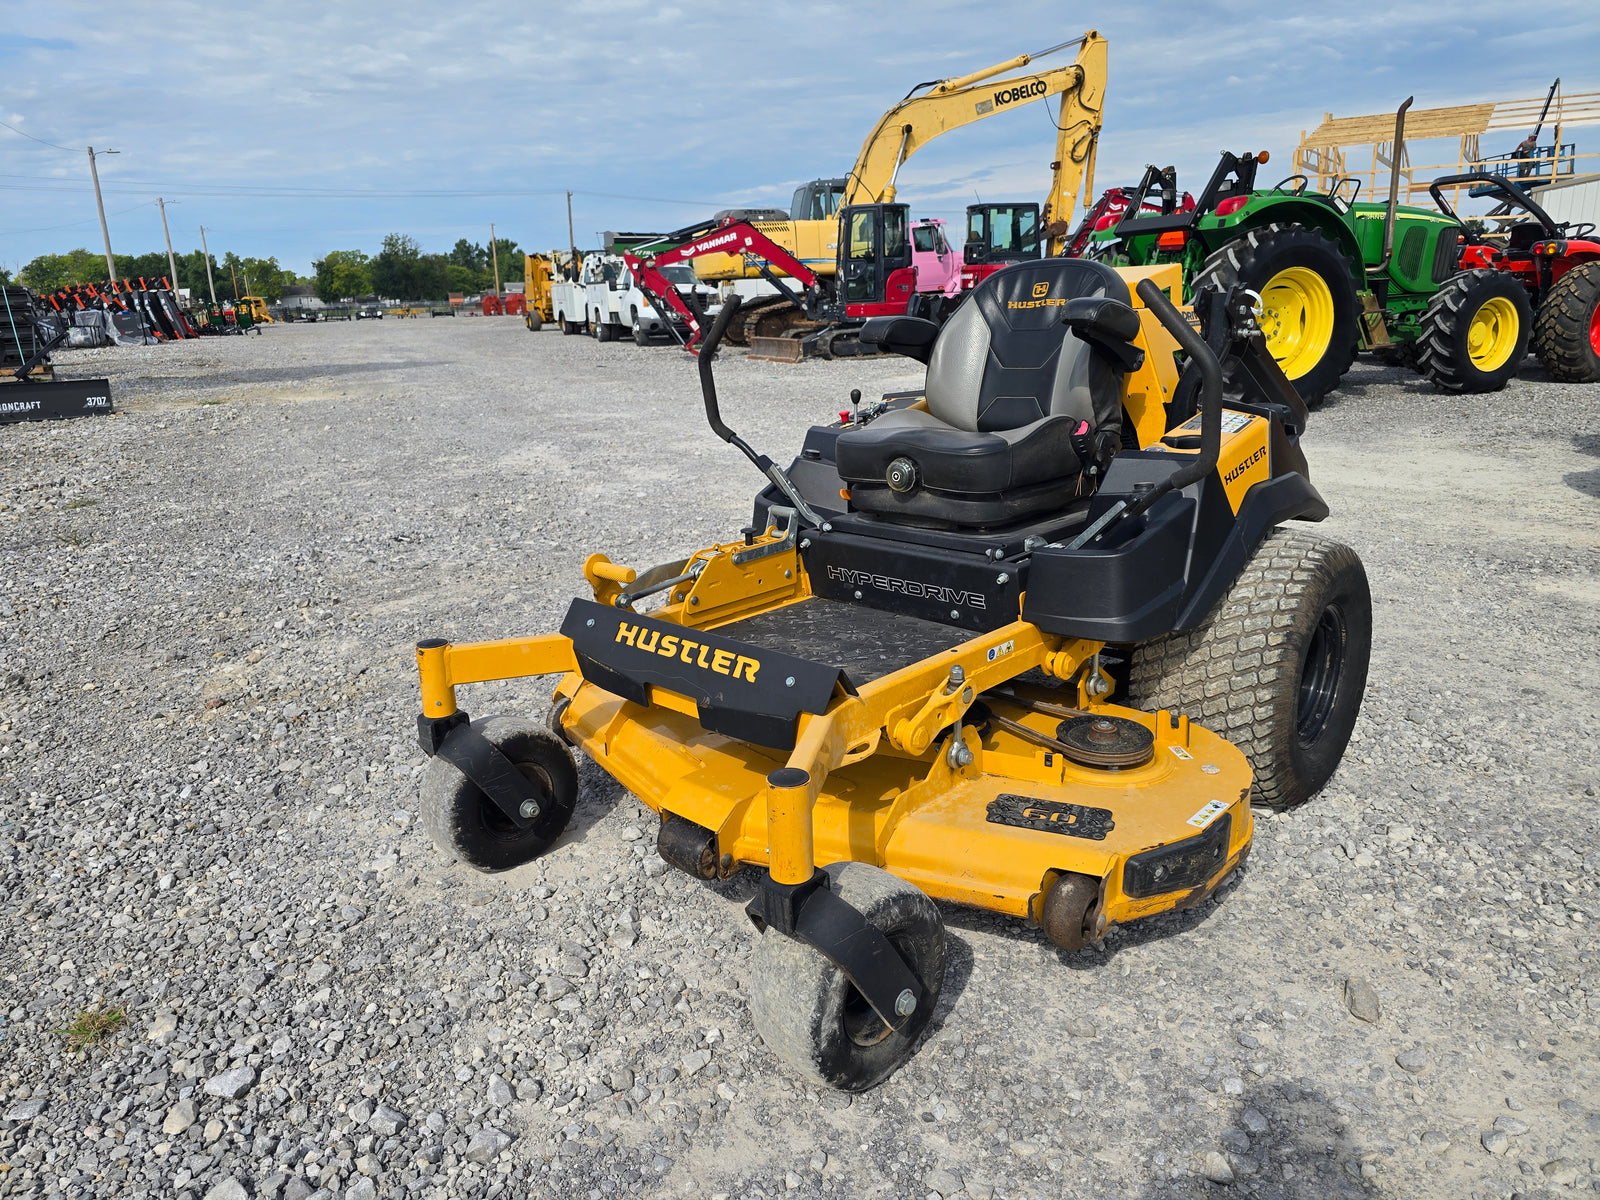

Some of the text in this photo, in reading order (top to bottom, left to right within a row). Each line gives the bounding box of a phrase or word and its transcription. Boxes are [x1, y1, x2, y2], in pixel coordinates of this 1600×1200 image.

[994, 80, 1047, 107] KOBELCO
[696, 232, 738, 252] YANMAR
[1007, 298, 1066, 309] HUSTLER
[86, 396, 107, 406] 3707
[1223, 445, 1267, 486] HUSTLER
[827, 565, 986, 609] HYPERDRIVE
[614, 621, 761, 683] HUSTLER
